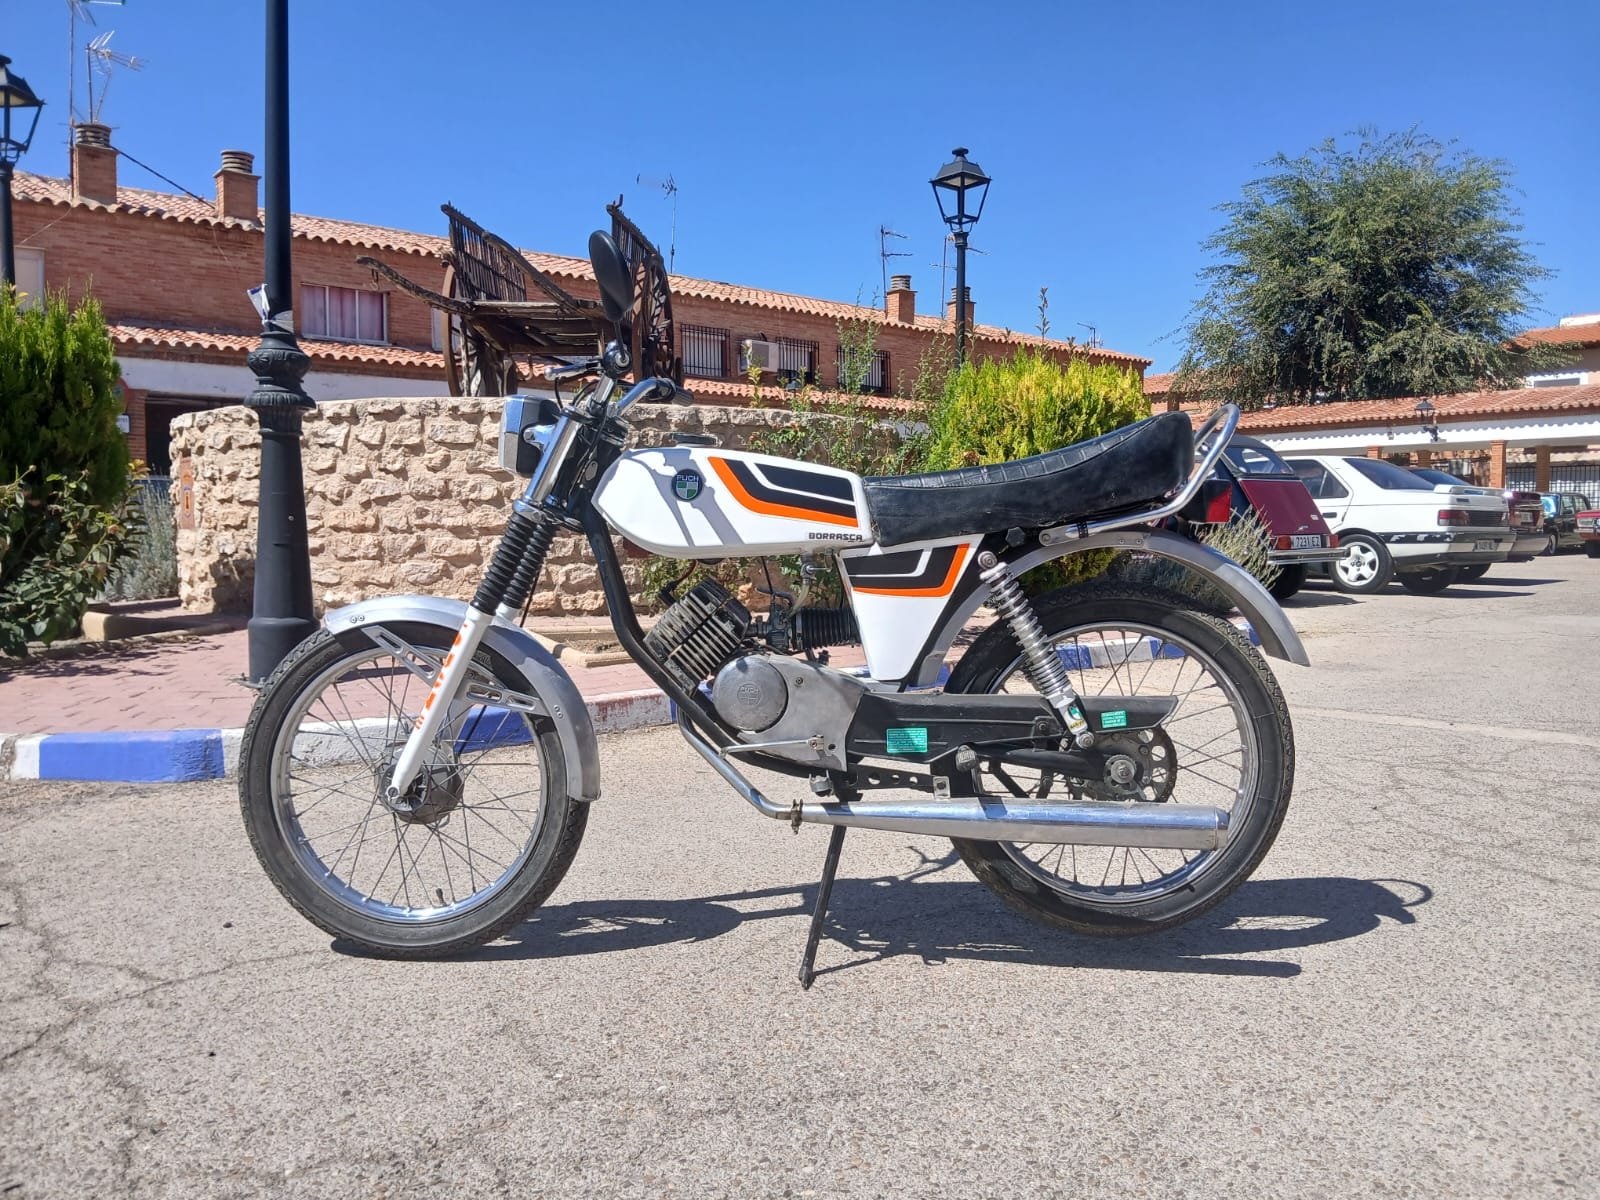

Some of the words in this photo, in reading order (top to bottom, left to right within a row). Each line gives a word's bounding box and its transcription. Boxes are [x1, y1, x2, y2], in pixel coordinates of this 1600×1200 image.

[676, 474, 699, 482] PUCH
[808, 532, 863, 542] BORRASCA
[740, 686, 760, 695] PUCH
